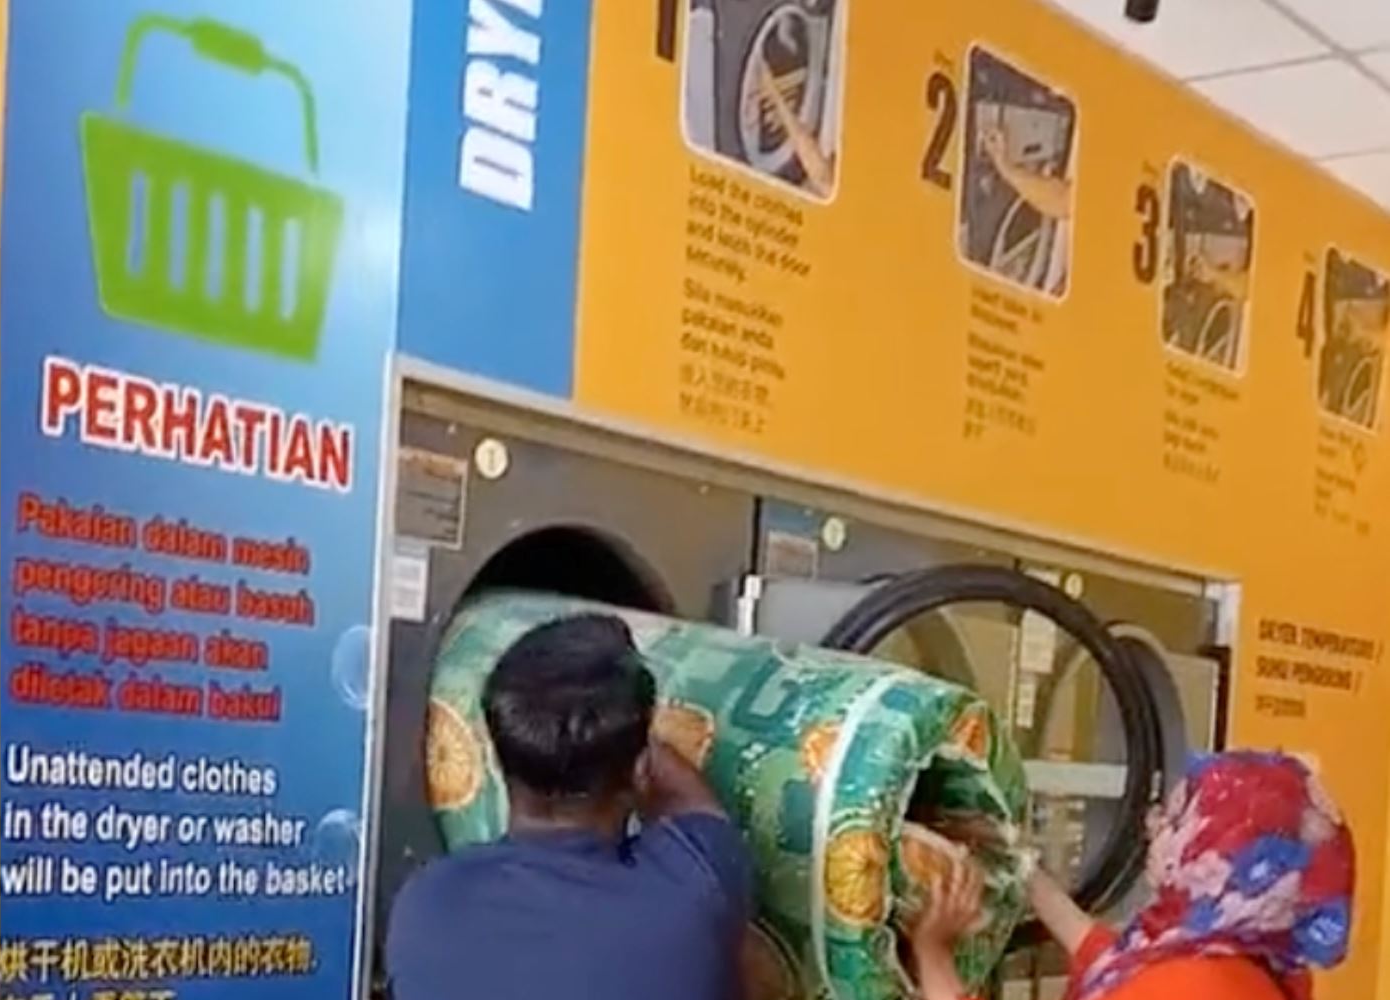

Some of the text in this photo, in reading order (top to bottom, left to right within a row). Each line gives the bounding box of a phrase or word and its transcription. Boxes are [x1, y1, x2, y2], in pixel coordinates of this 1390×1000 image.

[459, 0, 543, 211] DRY
[921, 72, 958, 191] 2
[1134, 185, 1160, 284] 3
[1296, 271, 1316, 358] 4
[42, 357, 353, 491] PERHATIAN
[18, 493, 309, 575] Pakaian dalam mesin
[14, 557, 314, 625] pengering atau basuh
[12, 606, 268, 671] tanpa jagaan akan
[10, 662, 281, 721] diletak dalam bakul
[7, 744, 277, 796] Unattended clothes
[5, 802, 305, 849] in the dryer or washer
[1, 857, 52, 894] will
[62, 859, 96, 895] be
[105, 866, 152, 901] put
[160, 862, 212, 894] into
[220, 864, 258, 895] the
